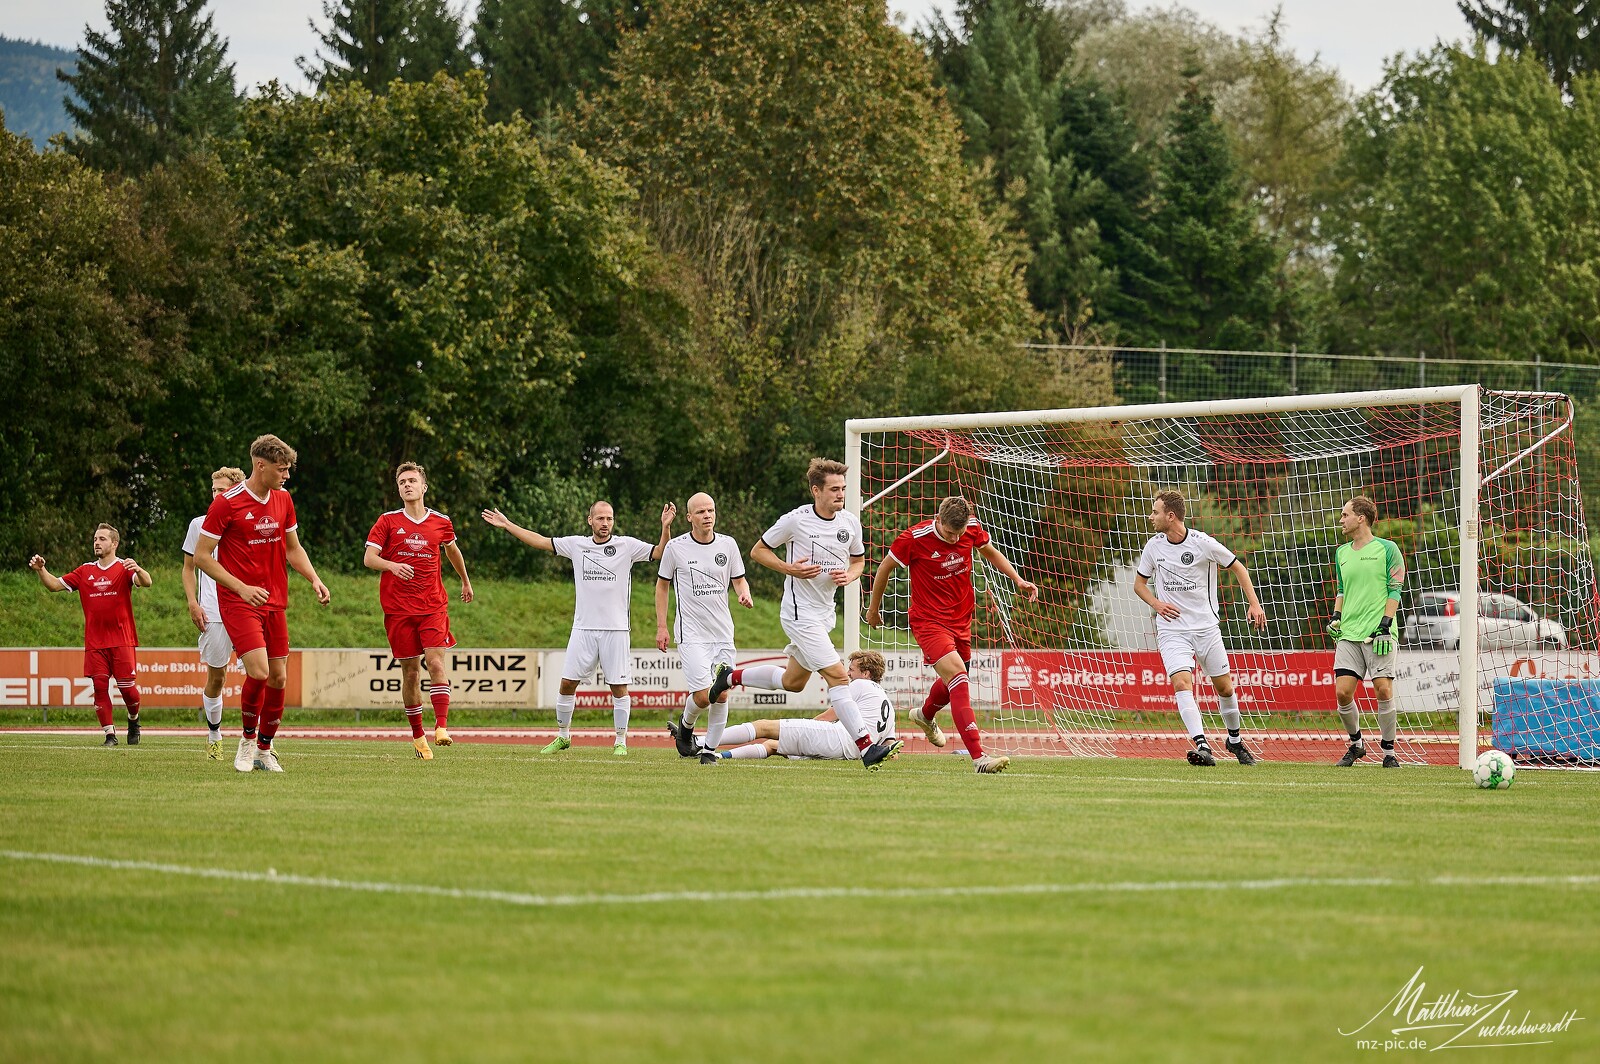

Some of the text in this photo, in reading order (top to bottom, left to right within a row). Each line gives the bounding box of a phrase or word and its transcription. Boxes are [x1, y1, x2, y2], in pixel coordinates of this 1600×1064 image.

[136, 662, 149, 673] An
[150, 662, 168, 673] der
[170, 662, 196, 673] B304
[198, 662, 207, 672] in
[452, 655, 526, 671] HINZ
[1038, 669, 1136, 688] Sparkasse
[756, 694, 785, 704] textil
[877, 699, 890, 733] 9
